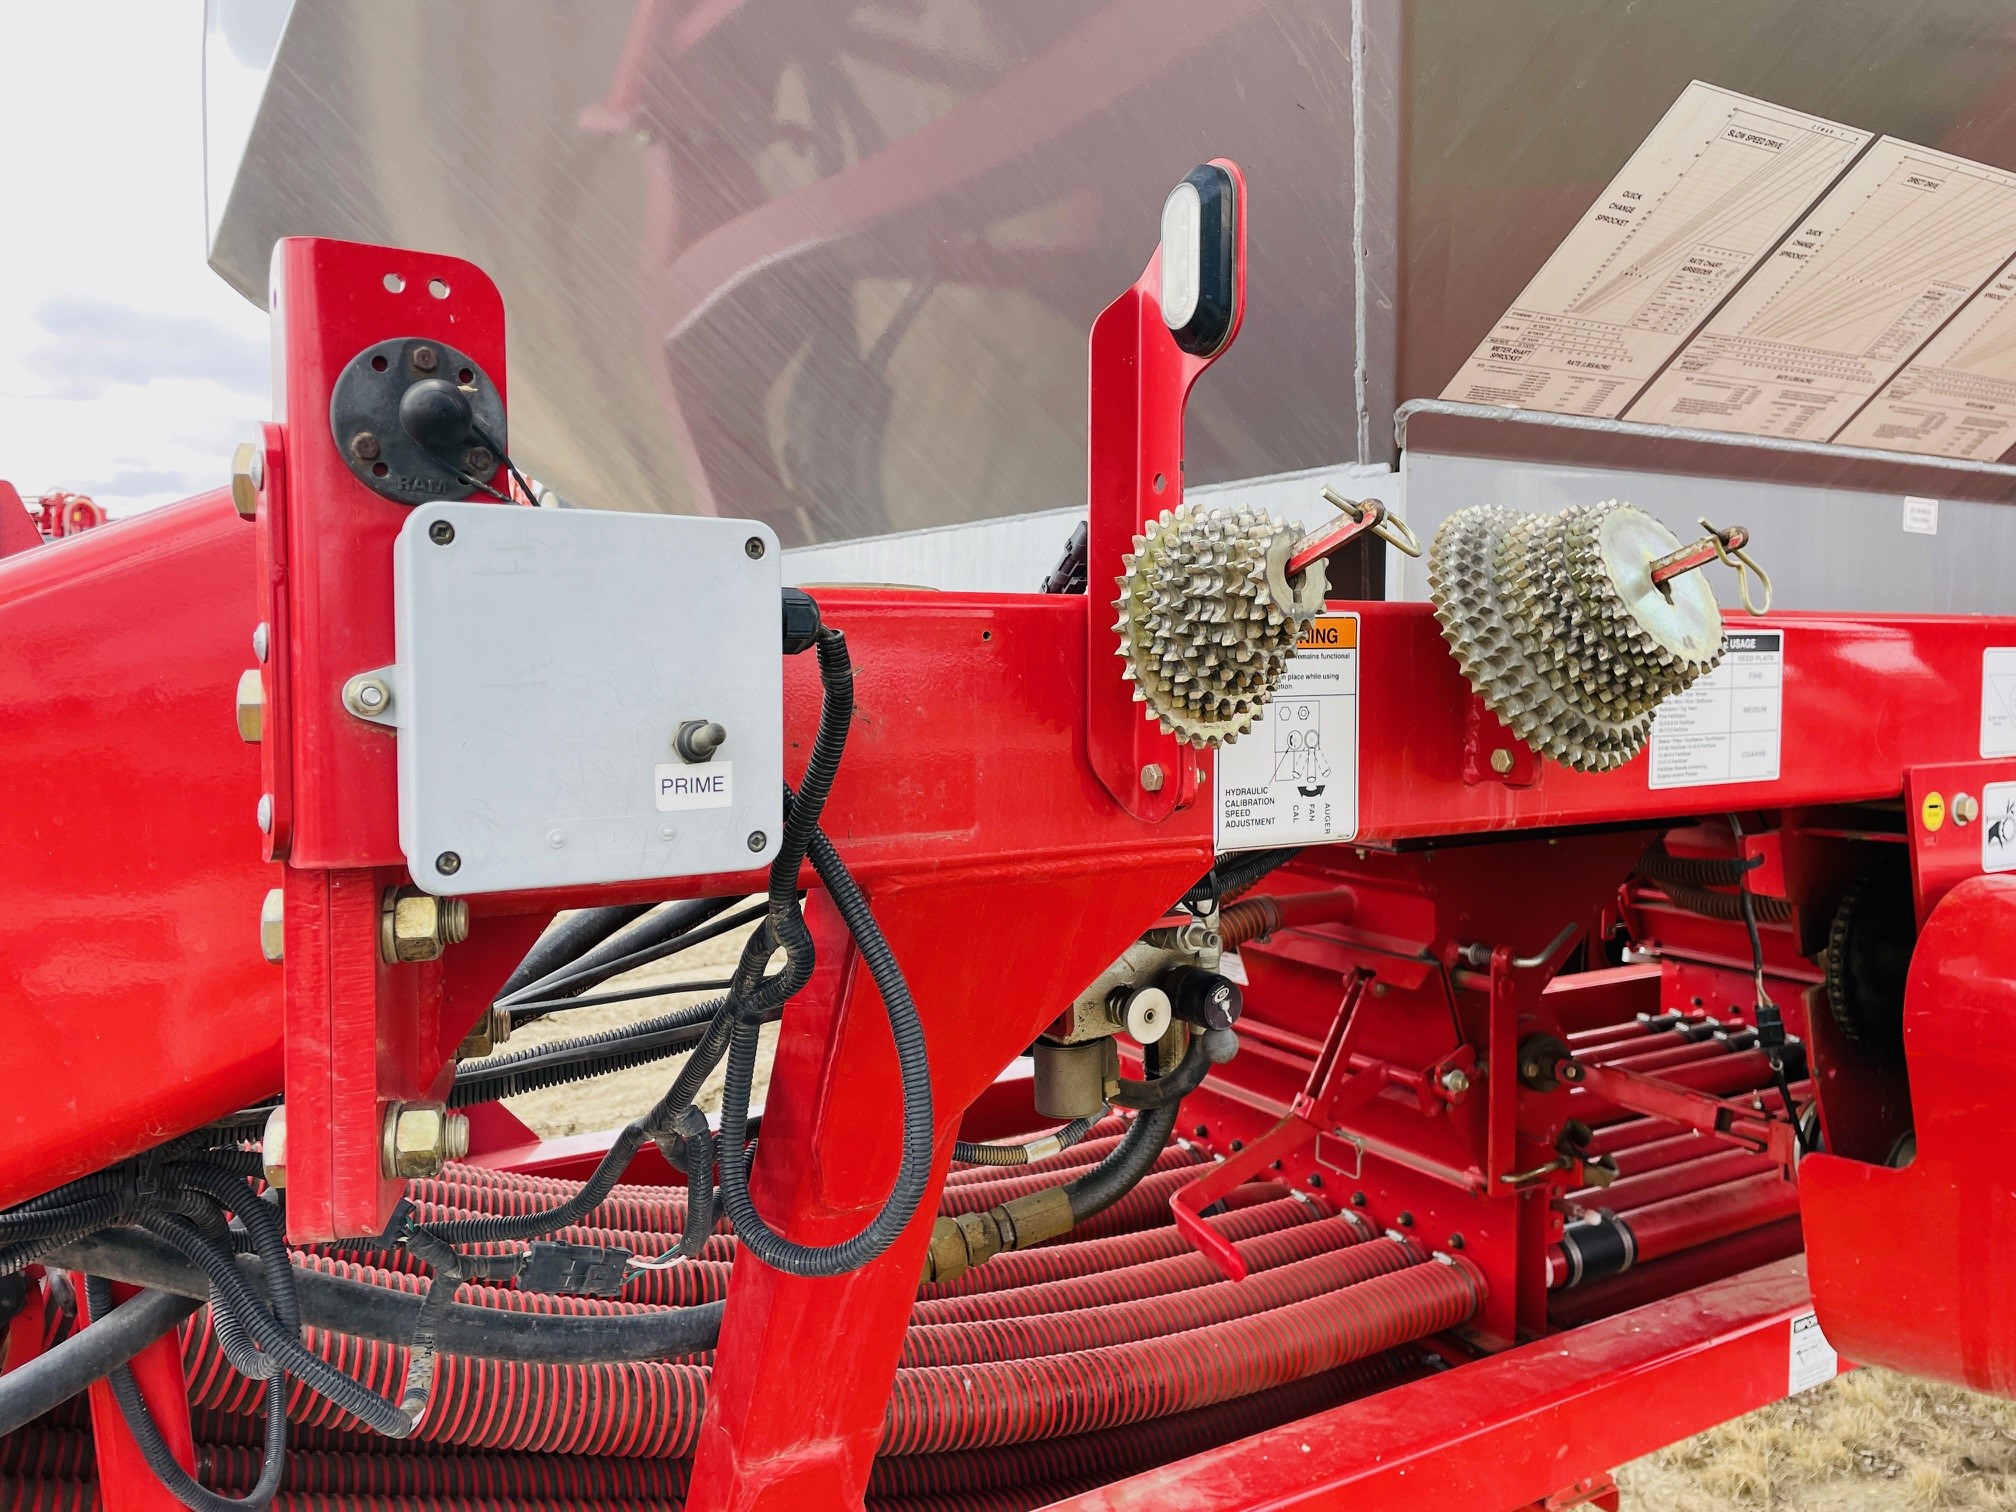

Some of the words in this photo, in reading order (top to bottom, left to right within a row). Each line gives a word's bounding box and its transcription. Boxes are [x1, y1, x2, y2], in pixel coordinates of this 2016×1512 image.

[1727, 128, 1746, 140] SLOW
[1745, 132, 1764, 146] SPEED
[1764, 138, 1784, 150] DRIVE
[1622, 190, 1644, 201] QUICK
[1608, 202, 1636, 214] CHANGE
[1595, 214, 1629, 227] SPROCKET
[397, 477, 448, 495] RAM
[1729, 638, 1757, 650] USAGE
[1320, 652, 1351, 660] functional
[1287, 673, 1305, 681] place
[1322, 673, 1340, 681] using
[1741, 750, 1767, 758] COARSE
[661, 775, 724, 795] PRIME
[1225, 786, 1269, 797] HYDRAULIC
[1225, 797, 1275, 808] CALIBRATION
[1225, 809, 1251, 818] SPEED
[1292, 804, 1300, 824] CAL
[1225, 817, 1276, 829] ADJUSTMENT
